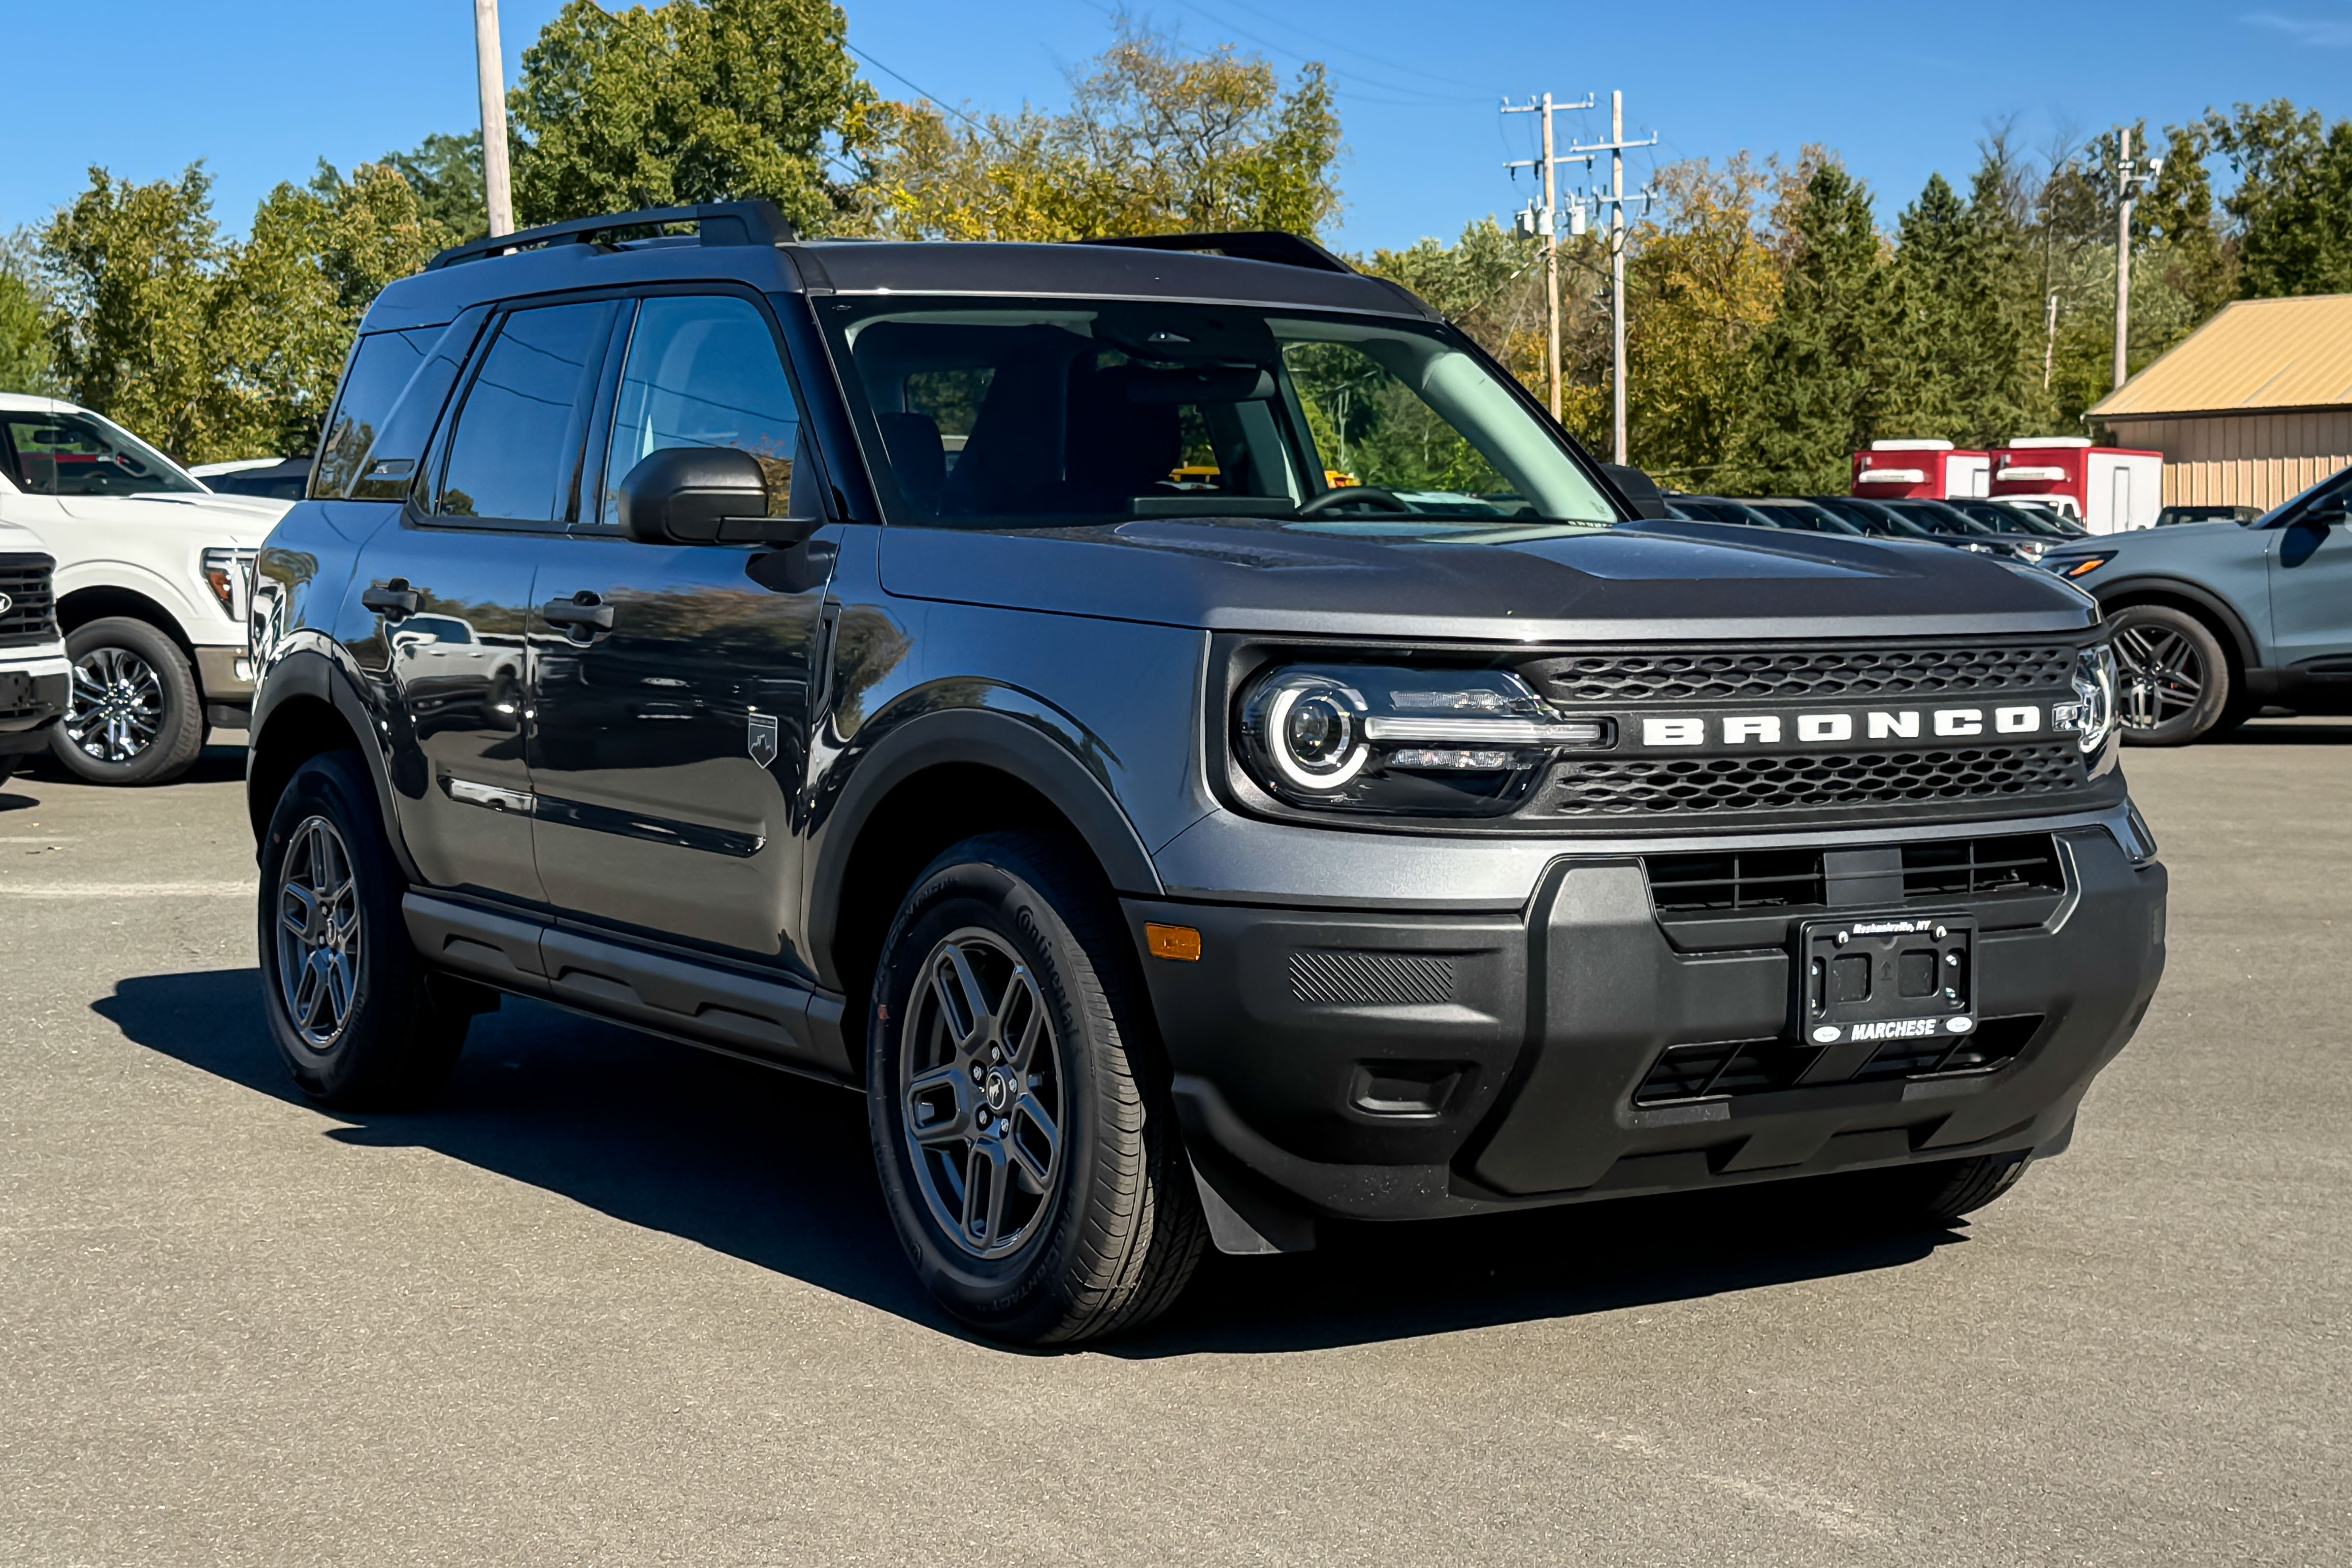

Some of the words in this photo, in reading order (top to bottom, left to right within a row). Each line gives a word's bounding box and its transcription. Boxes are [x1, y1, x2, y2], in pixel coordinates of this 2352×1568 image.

[1643, 705, 2040, 746] BRONCO
[1916, 920, 1932, 930] NY
[1016, 905, 1080, 1034] Continental
[1852, 1019, 1936, 1041] MARCHESE
